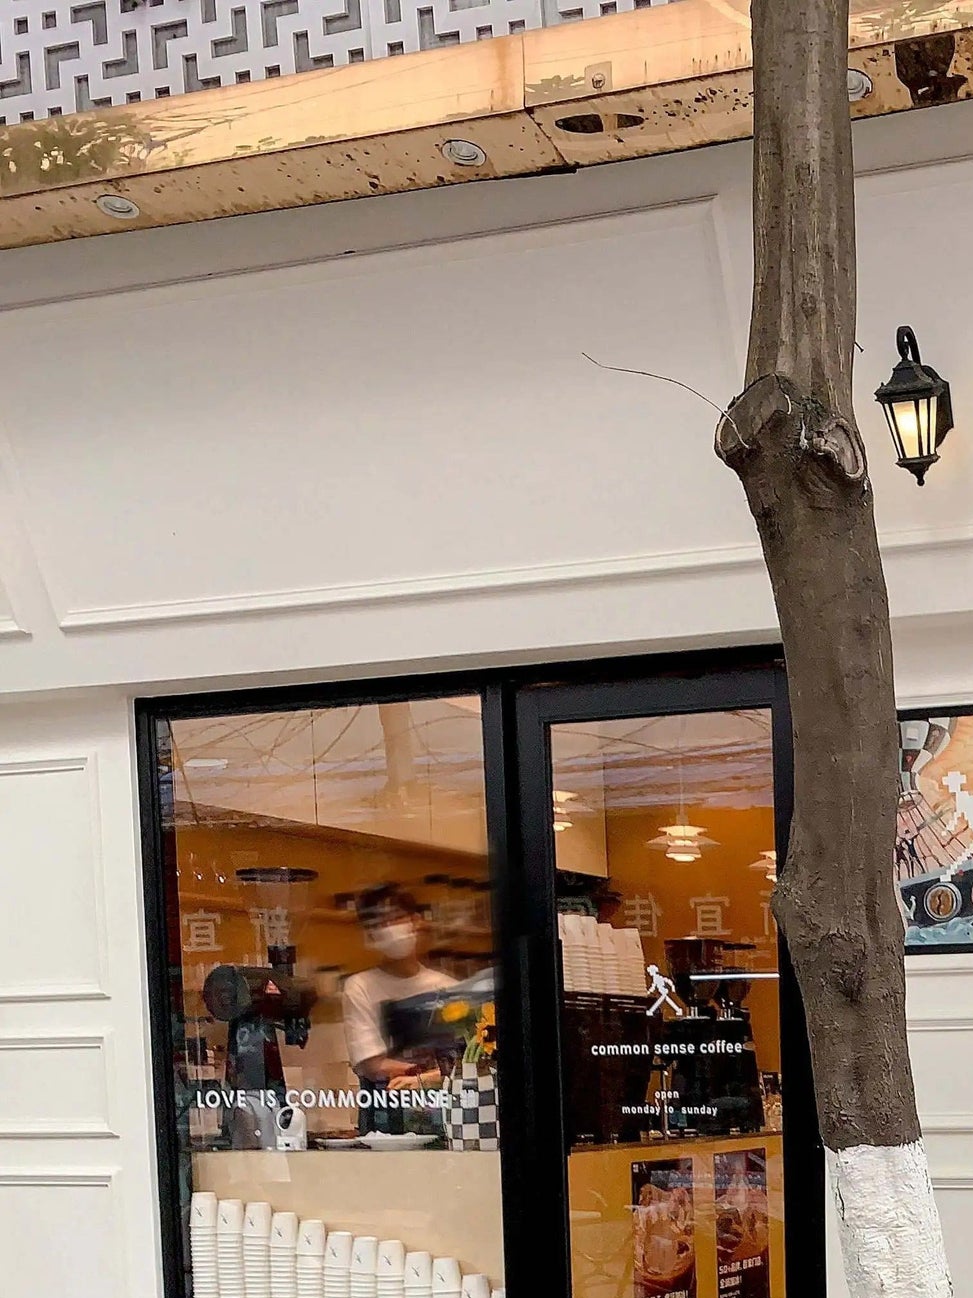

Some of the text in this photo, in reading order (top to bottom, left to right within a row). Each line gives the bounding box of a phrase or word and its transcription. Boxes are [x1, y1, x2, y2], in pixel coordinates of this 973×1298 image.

[591, 1039, 743, 1056] common sense coffee
[196, 1089, 247, 1109] LOVE
[259, 1089, 277, 1108] IS
[285, 1088, 450, 1109] COMMONSENSE
[654, 1090, 680, 1100] open
[621, 1104, 718, 1116] monday to sunday
